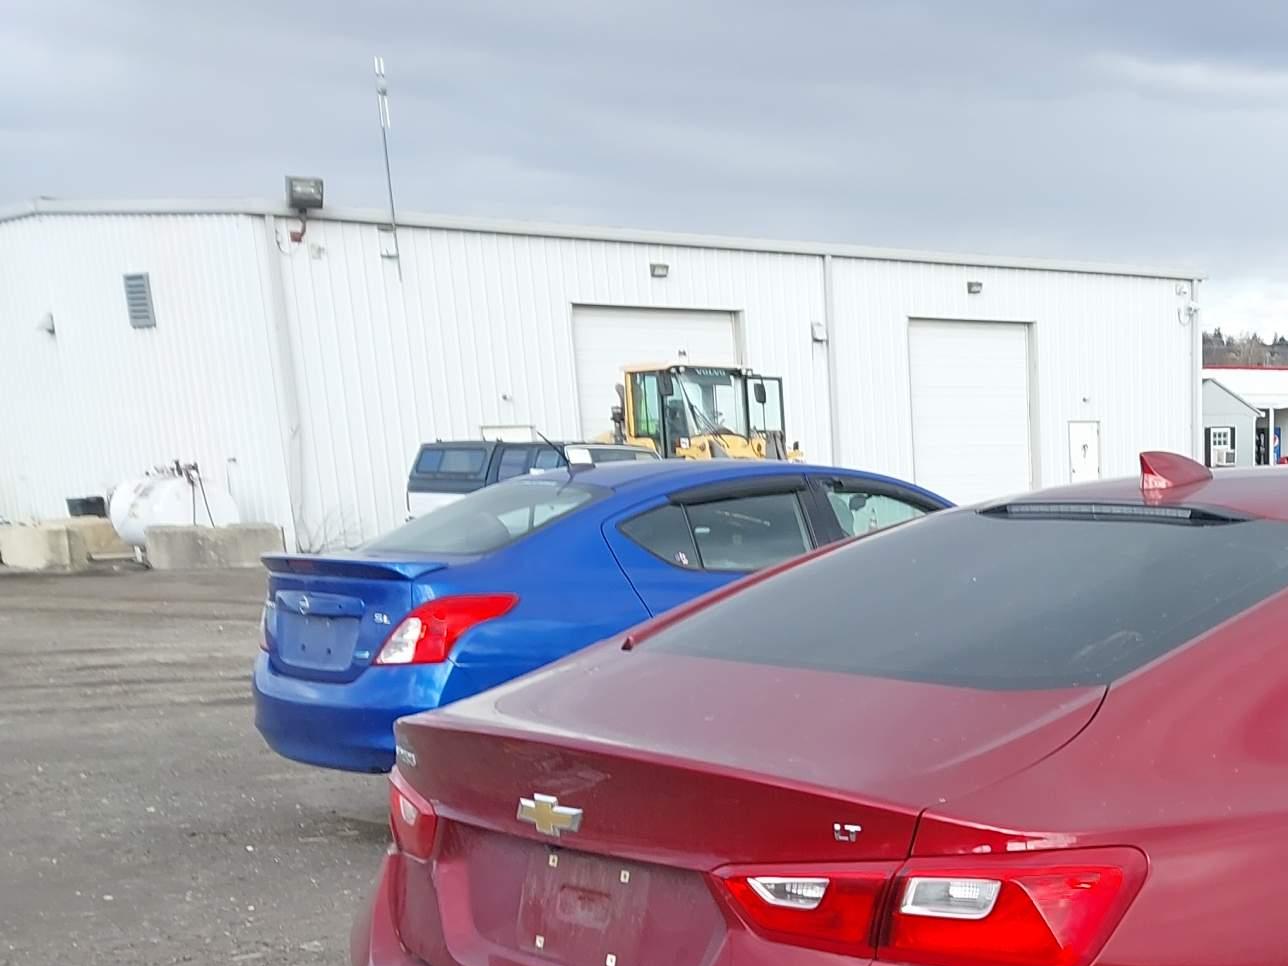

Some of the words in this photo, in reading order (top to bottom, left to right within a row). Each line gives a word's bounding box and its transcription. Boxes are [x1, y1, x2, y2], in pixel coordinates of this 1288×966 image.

[695, 368, 726, 376] VOLVO
[374, 612, 391, 625] SL
[833, 822, 862, 843] LT
